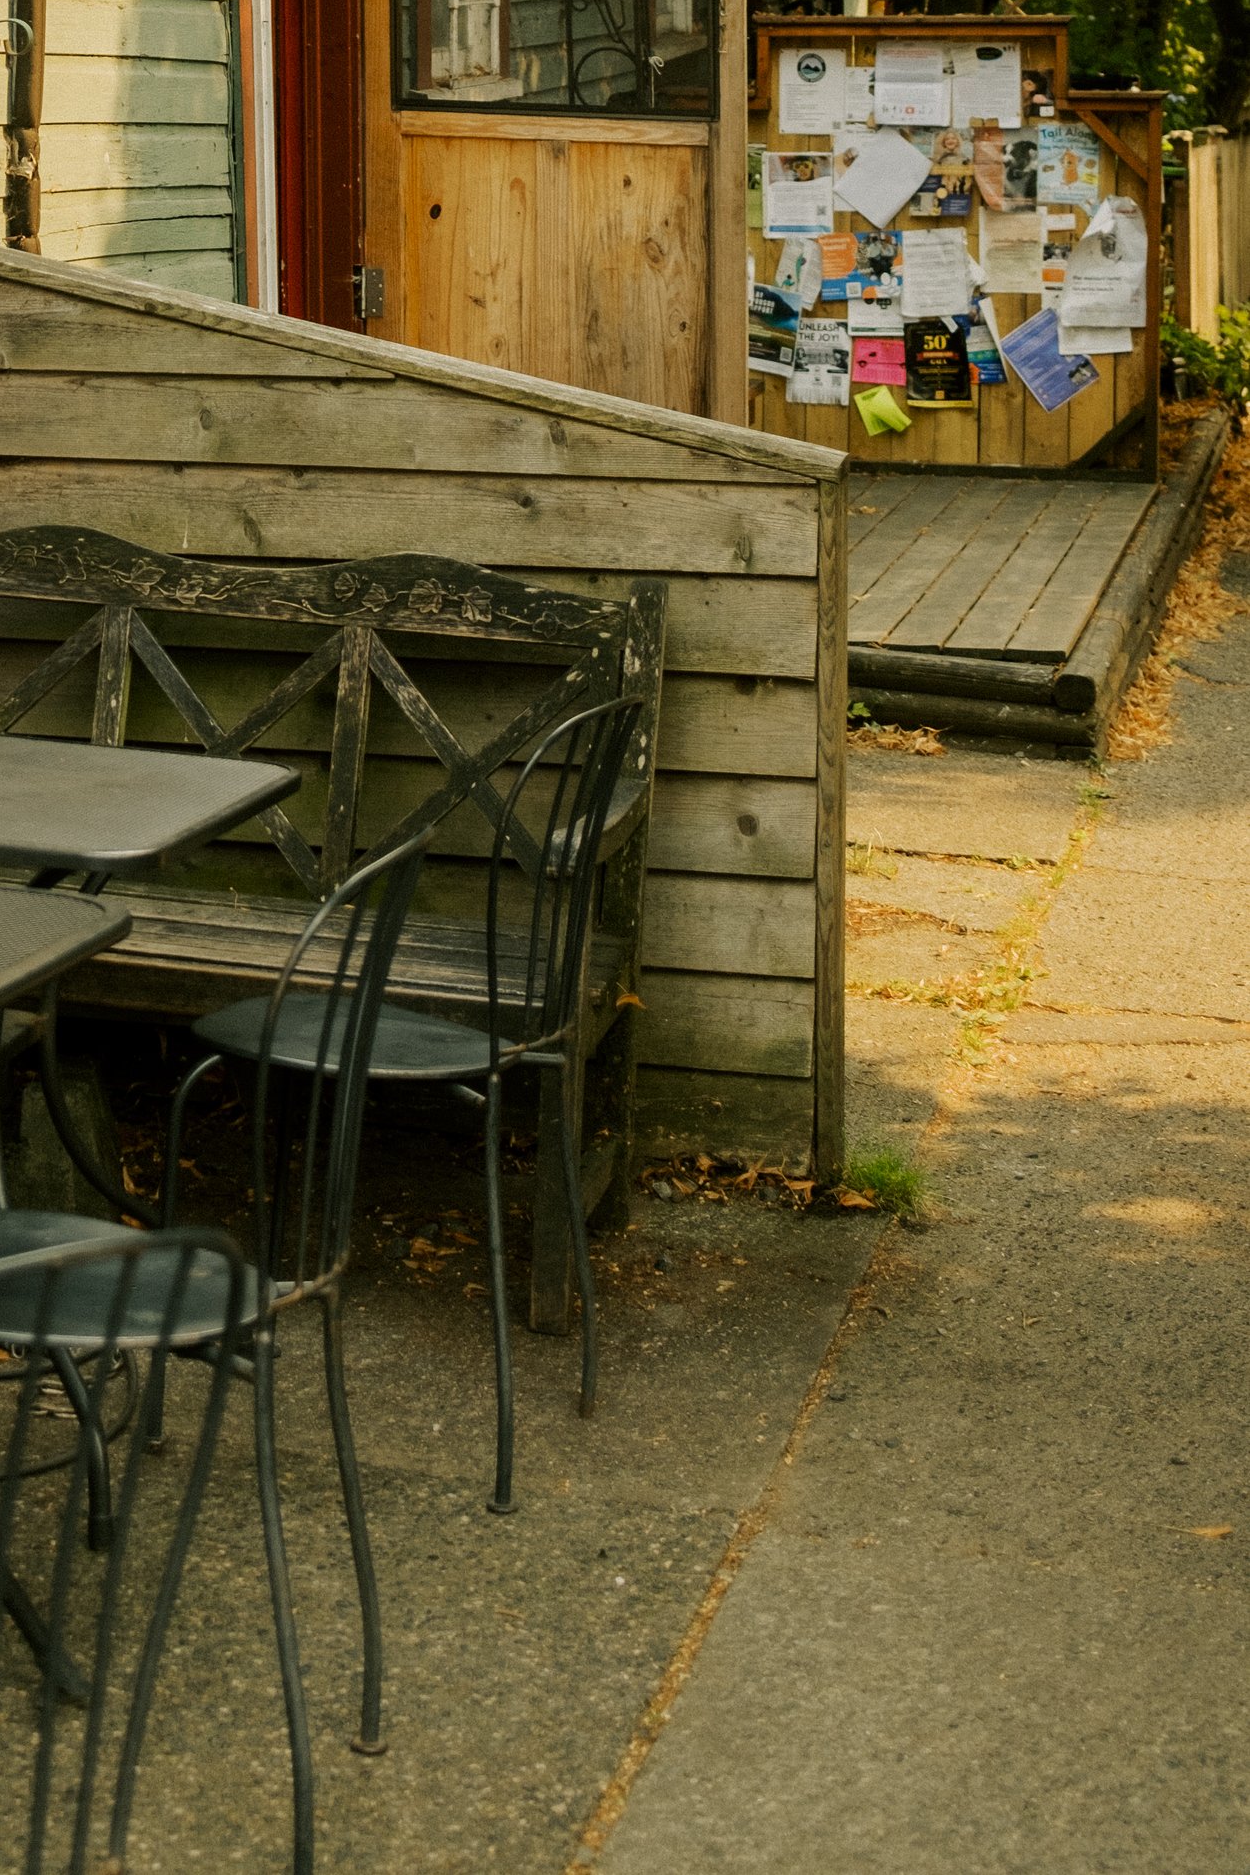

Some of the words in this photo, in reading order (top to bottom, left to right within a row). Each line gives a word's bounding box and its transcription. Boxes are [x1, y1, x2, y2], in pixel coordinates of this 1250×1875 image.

[1040, 126, 1062, 138] Tail
[799, 323, 840, 332] UNLEASH
[799, 332, 815, 341] THE
[817, 333, 840, 342] JOY!
